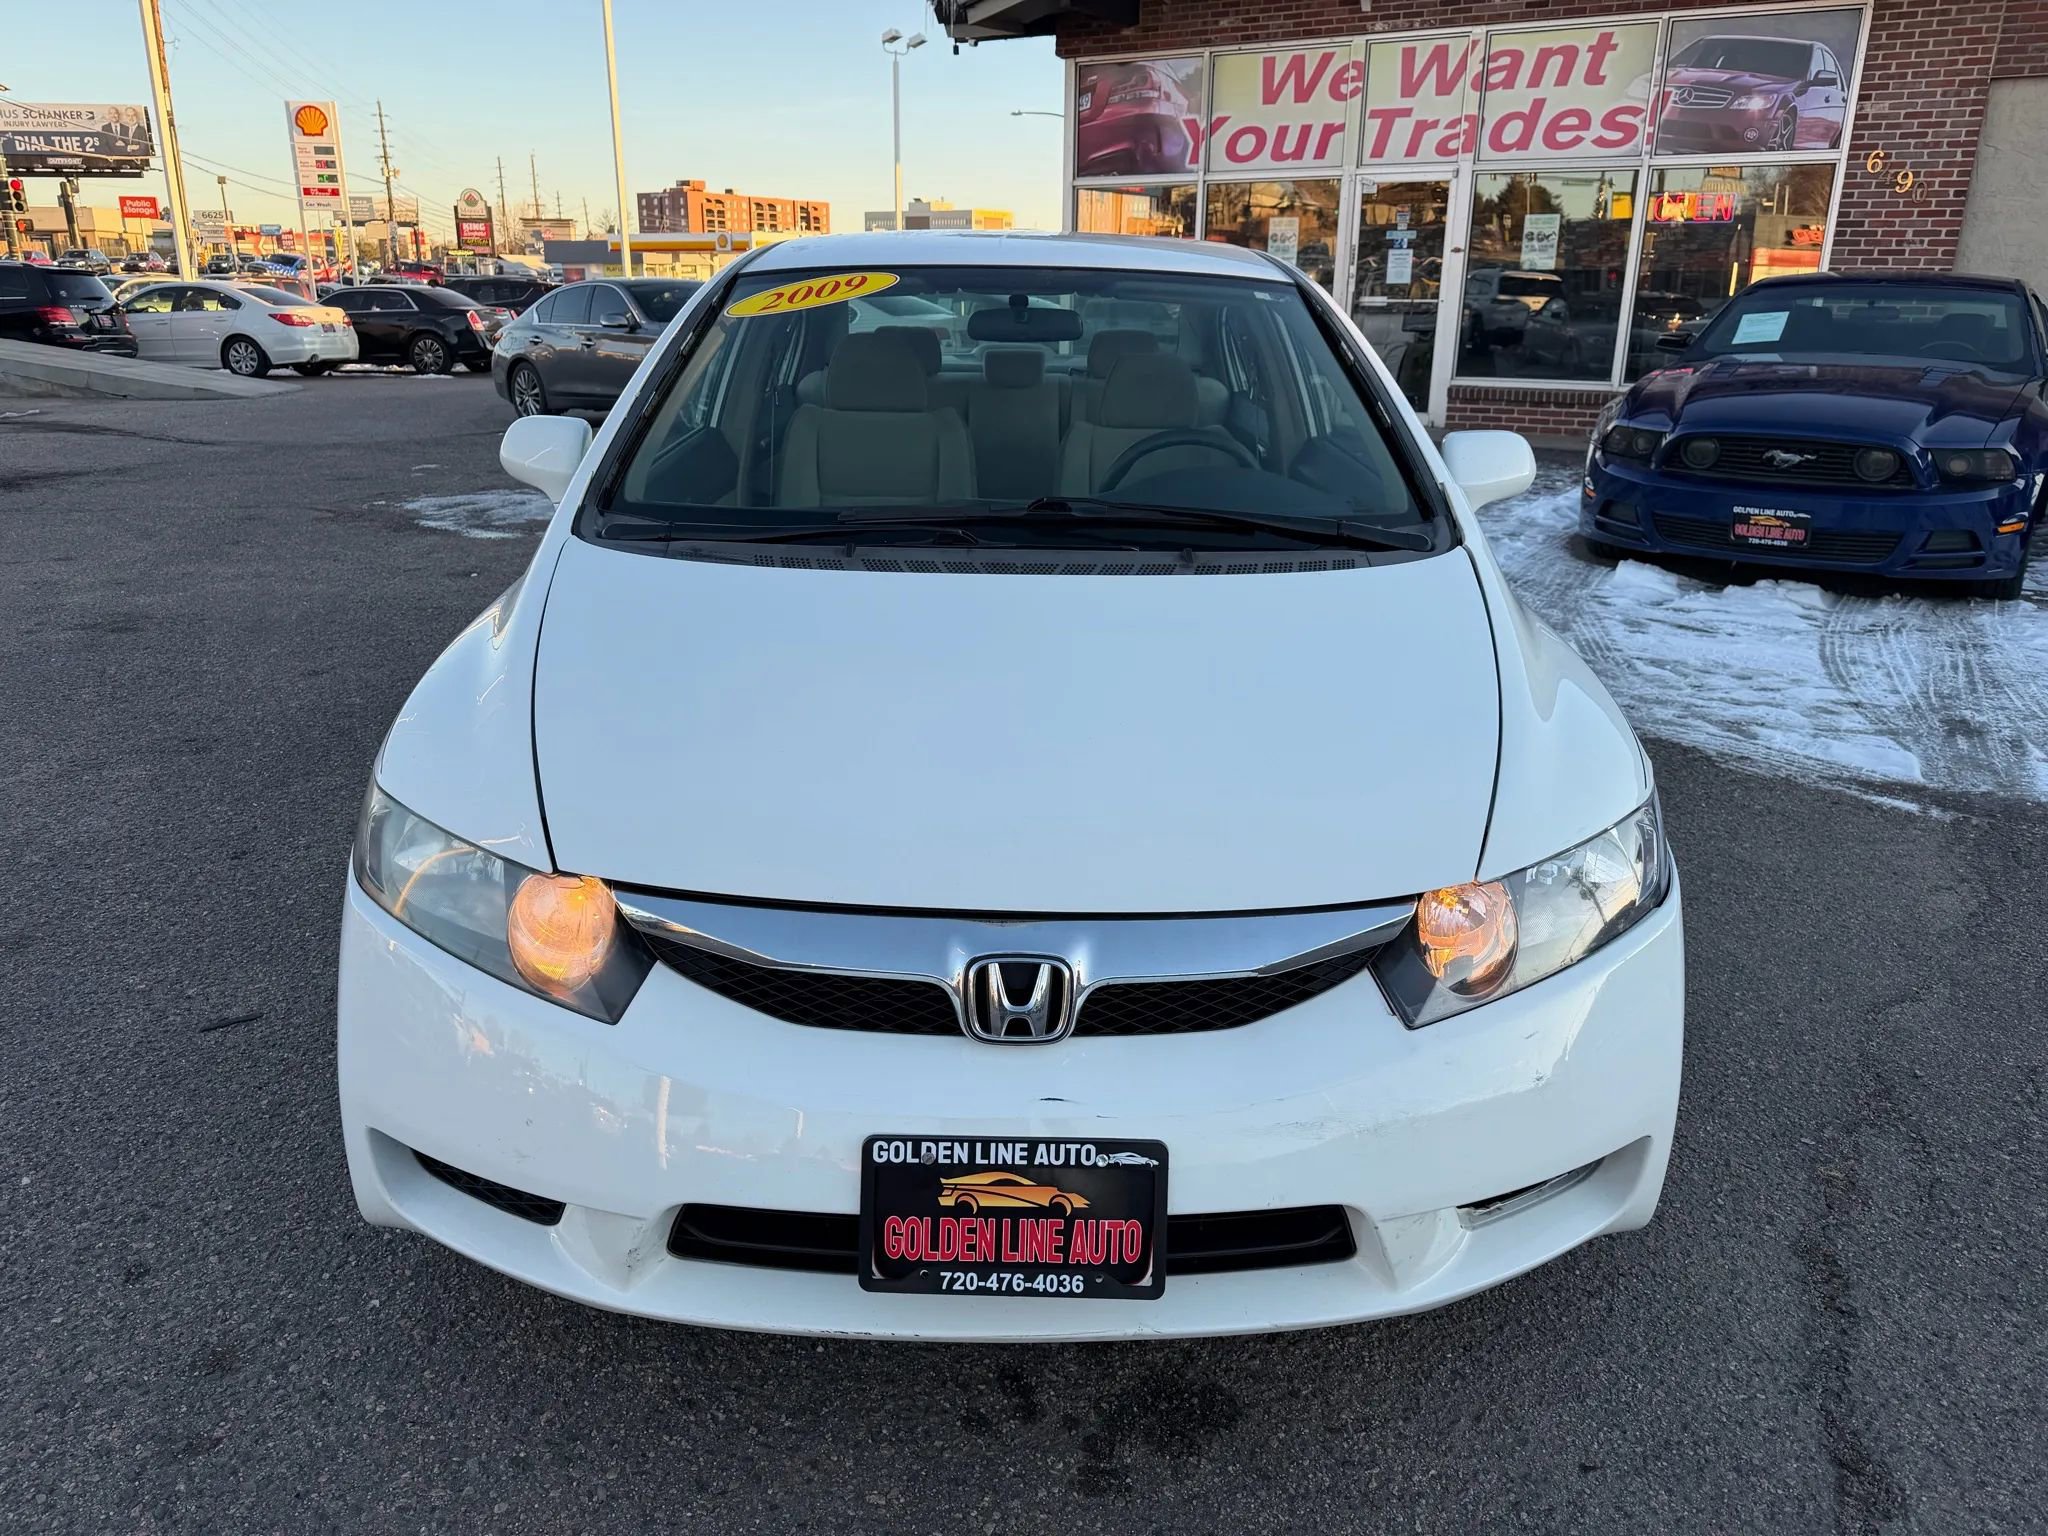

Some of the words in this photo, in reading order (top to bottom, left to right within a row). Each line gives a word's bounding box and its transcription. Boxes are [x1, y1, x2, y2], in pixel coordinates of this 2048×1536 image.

[1261, 51, 1364, 106] We
[1401, 31, 1618, 99] Want
[0, 109, 18, 119] US
[23, 109, 83, 120] SCHANKER
[4, 120, 30, 128] INJURY
[31, 121, 68, 129] LAWYERS
[1183, 114, 1346, 166] Your
[1367, 90, 1671, 160] Trades!
[15, 135, 50, 152] DIAL
[51, 136, 83, 152] THE
[1866, 149, 1928, 203] 6490
[123, 206, 155, 215] Storage
[126, 199, 151, 207] Public
[201, 211, 224, 219] 6625
[462, 222, 486, 231] KING
[757, 275, 868, 312] 2009
[1733, 506, 1760, 515] GOLDEN
[1776, 510, 1794, 518] AUTO
[1766, 526, 1784, 539] LINE
[1784, 528, 1805, 540] AUTO
[872, 1140, 969, 1165] GOLDEN
[975, 1142, 1028, 1165] LINE
[1034, 1143, 1097, 1166] AUTO
[884, 1215, 996, 1263] GOLDEN
[1002, 1218, 1064, 1264] LINE
[1069, 1219, 1142, 1265] AUTO
[939, 1271, 1084, 1294] 720-476-4036
